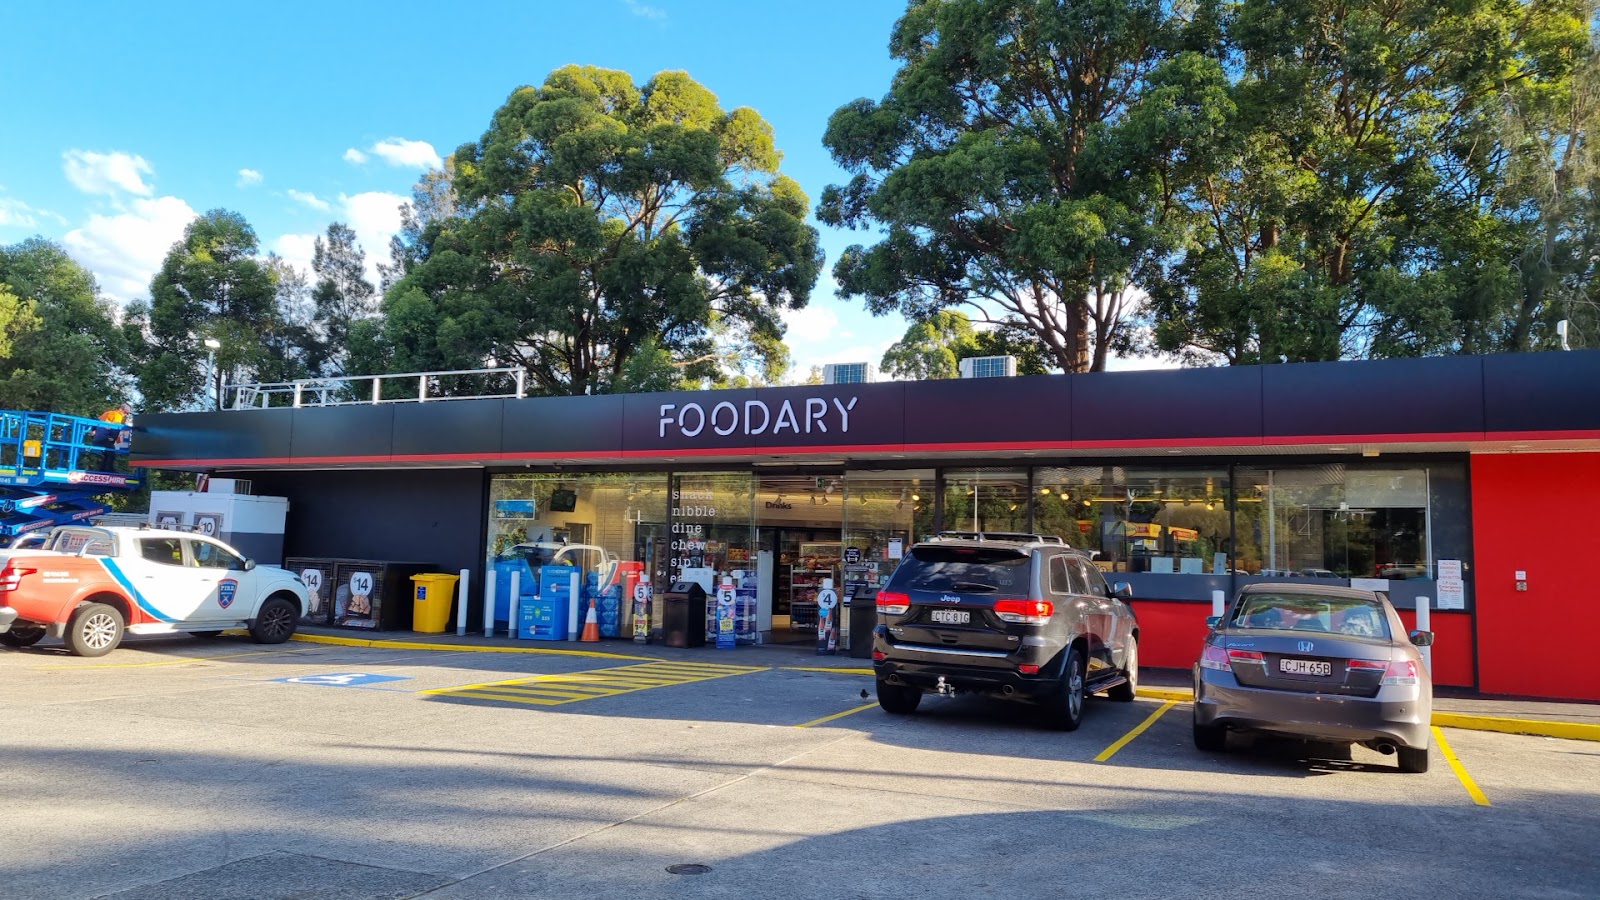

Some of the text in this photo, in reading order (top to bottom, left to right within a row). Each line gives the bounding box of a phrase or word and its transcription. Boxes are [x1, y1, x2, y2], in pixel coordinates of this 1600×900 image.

[659, 396, 858, 438] FOODARY
[673, 489, 713, 500] snack
[765, 501, 792, 510] Drinks
[672, 506, 716, 517] nibble
[671, 522, 702, 534] dine
[671, 539, 706, 550] chew
[670, 556, 691, 568] sip
[304, 574, 318, 587] $14
[354, 577, 368, 591] $14
[940, 594, 961, 603] Jeep
